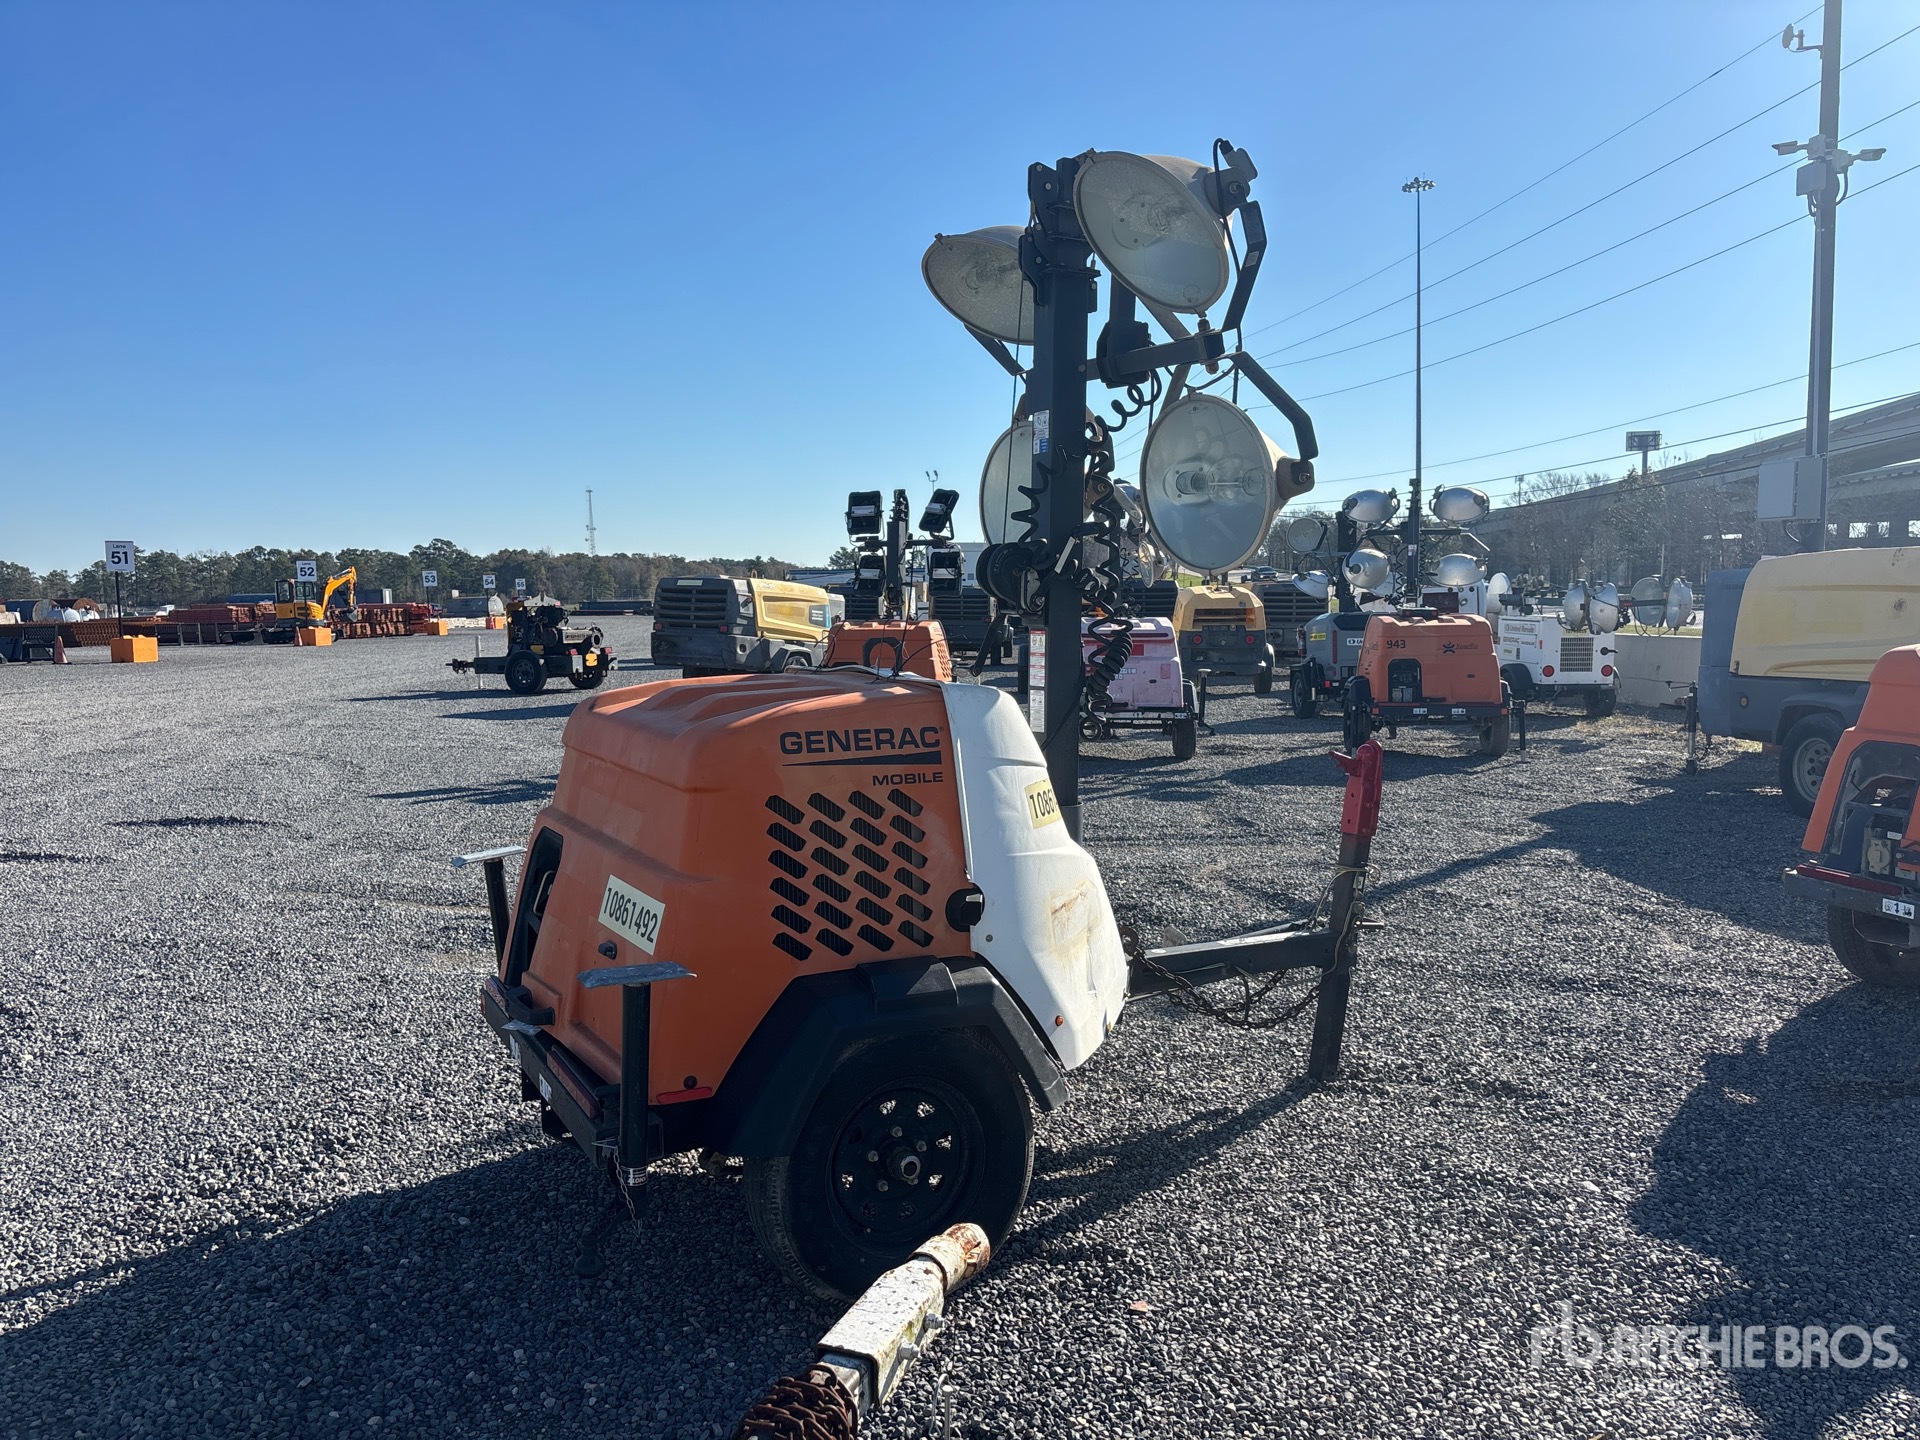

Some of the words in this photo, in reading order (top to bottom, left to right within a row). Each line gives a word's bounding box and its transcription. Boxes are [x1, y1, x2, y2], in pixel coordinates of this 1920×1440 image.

[111, 551, 128, 565] 51
[300, 567, 315, 577] 52
[425, 575, 436, 583] 53
[485, 578, 494, 586] 54
[1386, 639, 1407, 649] 943
[779, 726, 941, 755] GENERAC
[872, 771, 944, 786] MOBILE
[603, 887, 658, 944] 10861492
